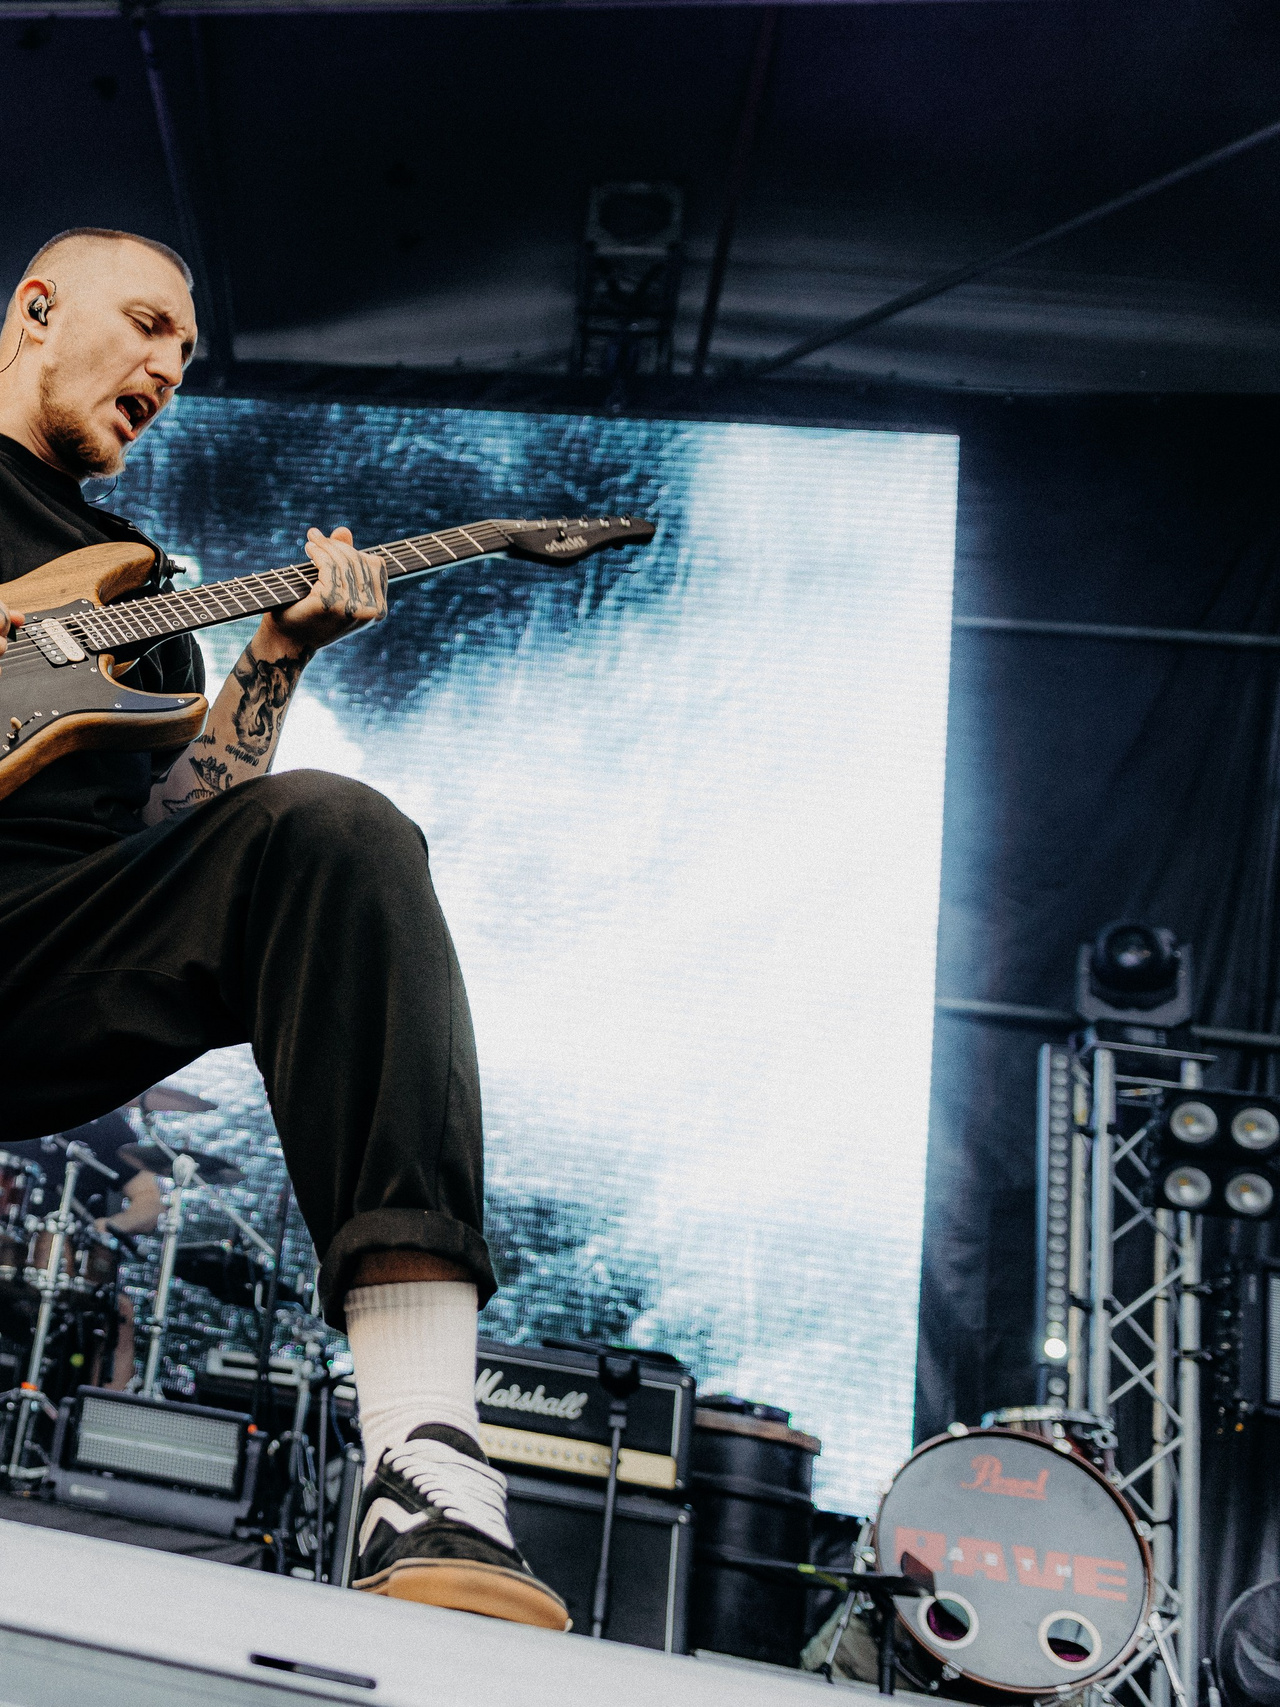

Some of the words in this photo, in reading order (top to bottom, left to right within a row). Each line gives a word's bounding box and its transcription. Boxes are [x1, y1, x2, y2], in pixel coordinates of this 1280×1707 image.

[475, 1367, 589, 1420] Marshall
[959, 1453, 1050, 1501] Pearl
[894, 1526, 1128, 1602] RAVE
